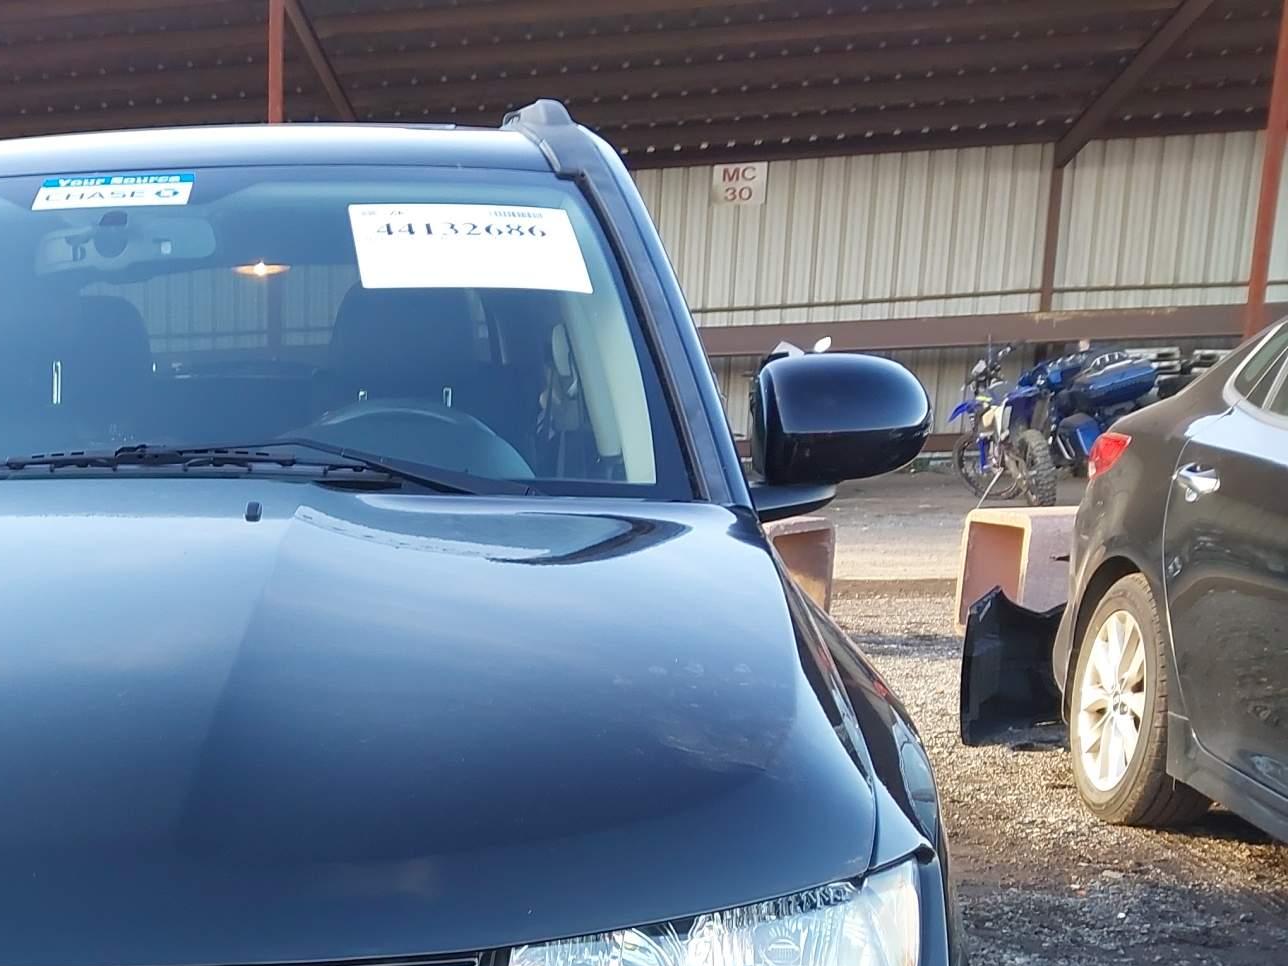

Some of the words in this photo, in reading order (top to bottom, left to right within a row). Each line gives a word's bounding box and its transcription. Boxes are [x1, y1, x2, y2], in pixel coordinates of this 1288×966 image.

[58, 178, 106, 187] Your
[111, 175, 181, 185] Source
[722, 166, 757, 182] MC
[45, 190, 145, 202] CHASE
[724, 186, 753, 202] 30
[376, 222, 547, 237] 44132686
